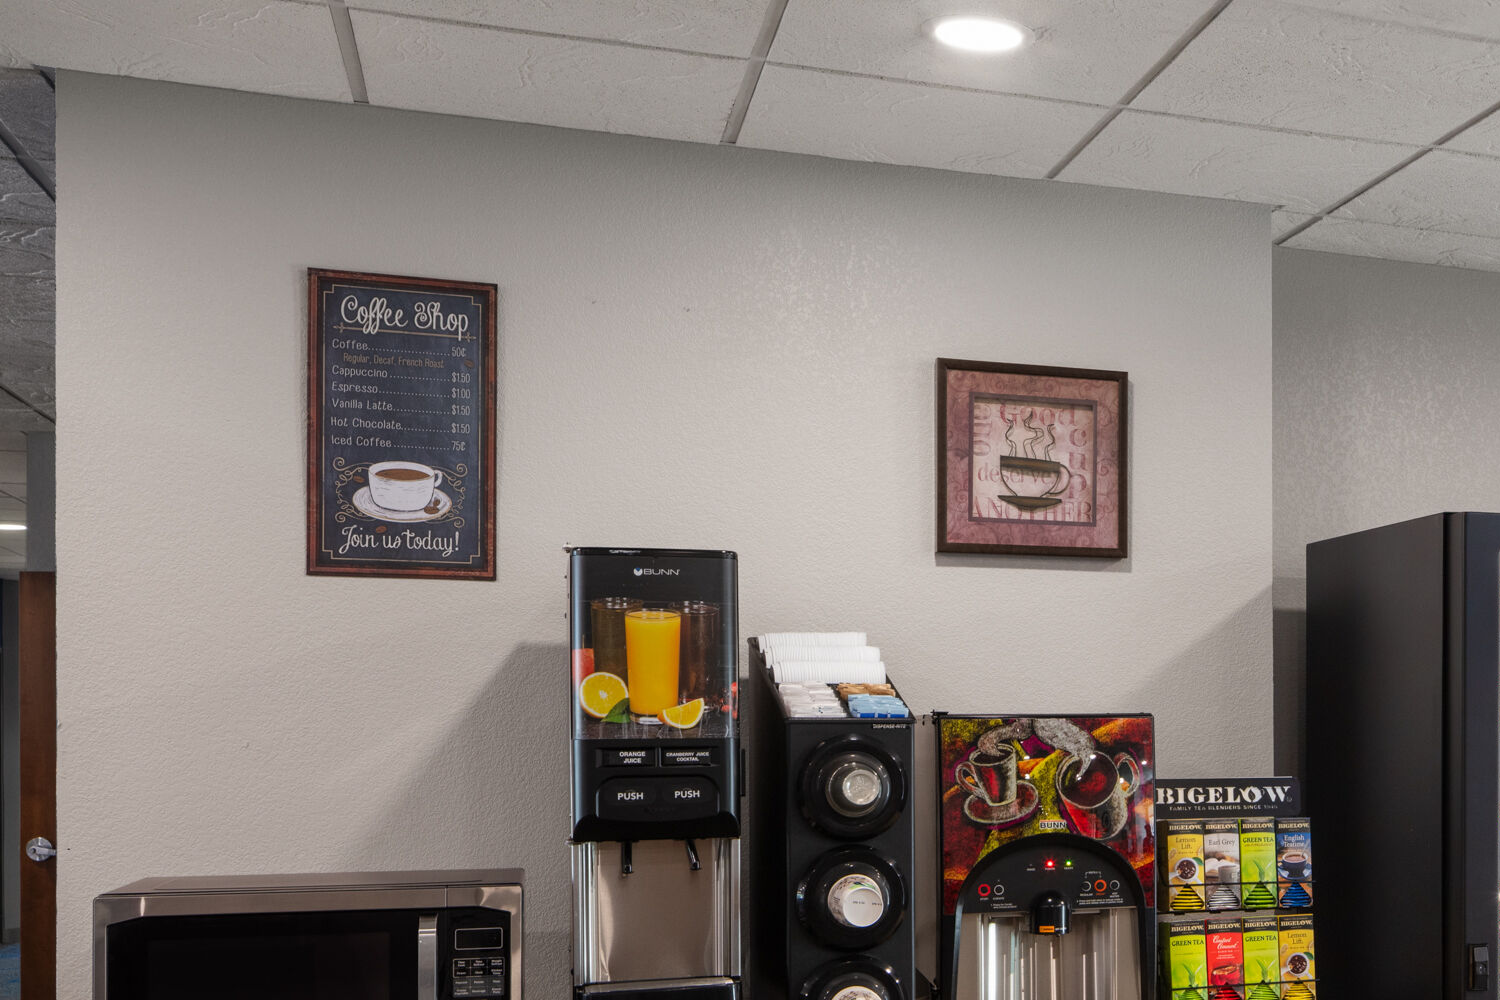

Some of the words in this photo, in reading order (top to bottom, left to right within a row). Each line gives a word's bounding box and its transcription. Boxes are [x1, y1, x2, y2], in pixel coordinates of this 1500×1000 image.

[341, 295, 408, 334] Coffee
[414, 302, 468, 341] Shop
[332, 338, 368, 350] Coffee
[398, 356, 422, 367] French
[425, 358, 444, 368] Roast
[332, 365, 388, 378] Cappuccino
[332, 381, 378, 393] Espresso
[332, 398, 362, 409] Vanilla
[367, 400, 393, 411] Latte
[331, 417, 348, 427] Hot
[352, 418, 402, 430] Chocolate
[331, 435, 352, 445] Iced
[356, 436, 392, 447] Coffee
[339, 524, 379, 555] Join
[382, 533, 401, 549] us
[401, 529, 460, 557] today!
[643, 568, 680, 576] BUNN
[617, 792, 644, 801] PUSH
[674, 790, 700, 799] PUSH
[1156, 785, 1291, 804] BIGELOW
[1040, 821, 1067, 829] BUNN
[1221, 839, 1235, 847] Grey
[1284, 834, 1305, 842] English
